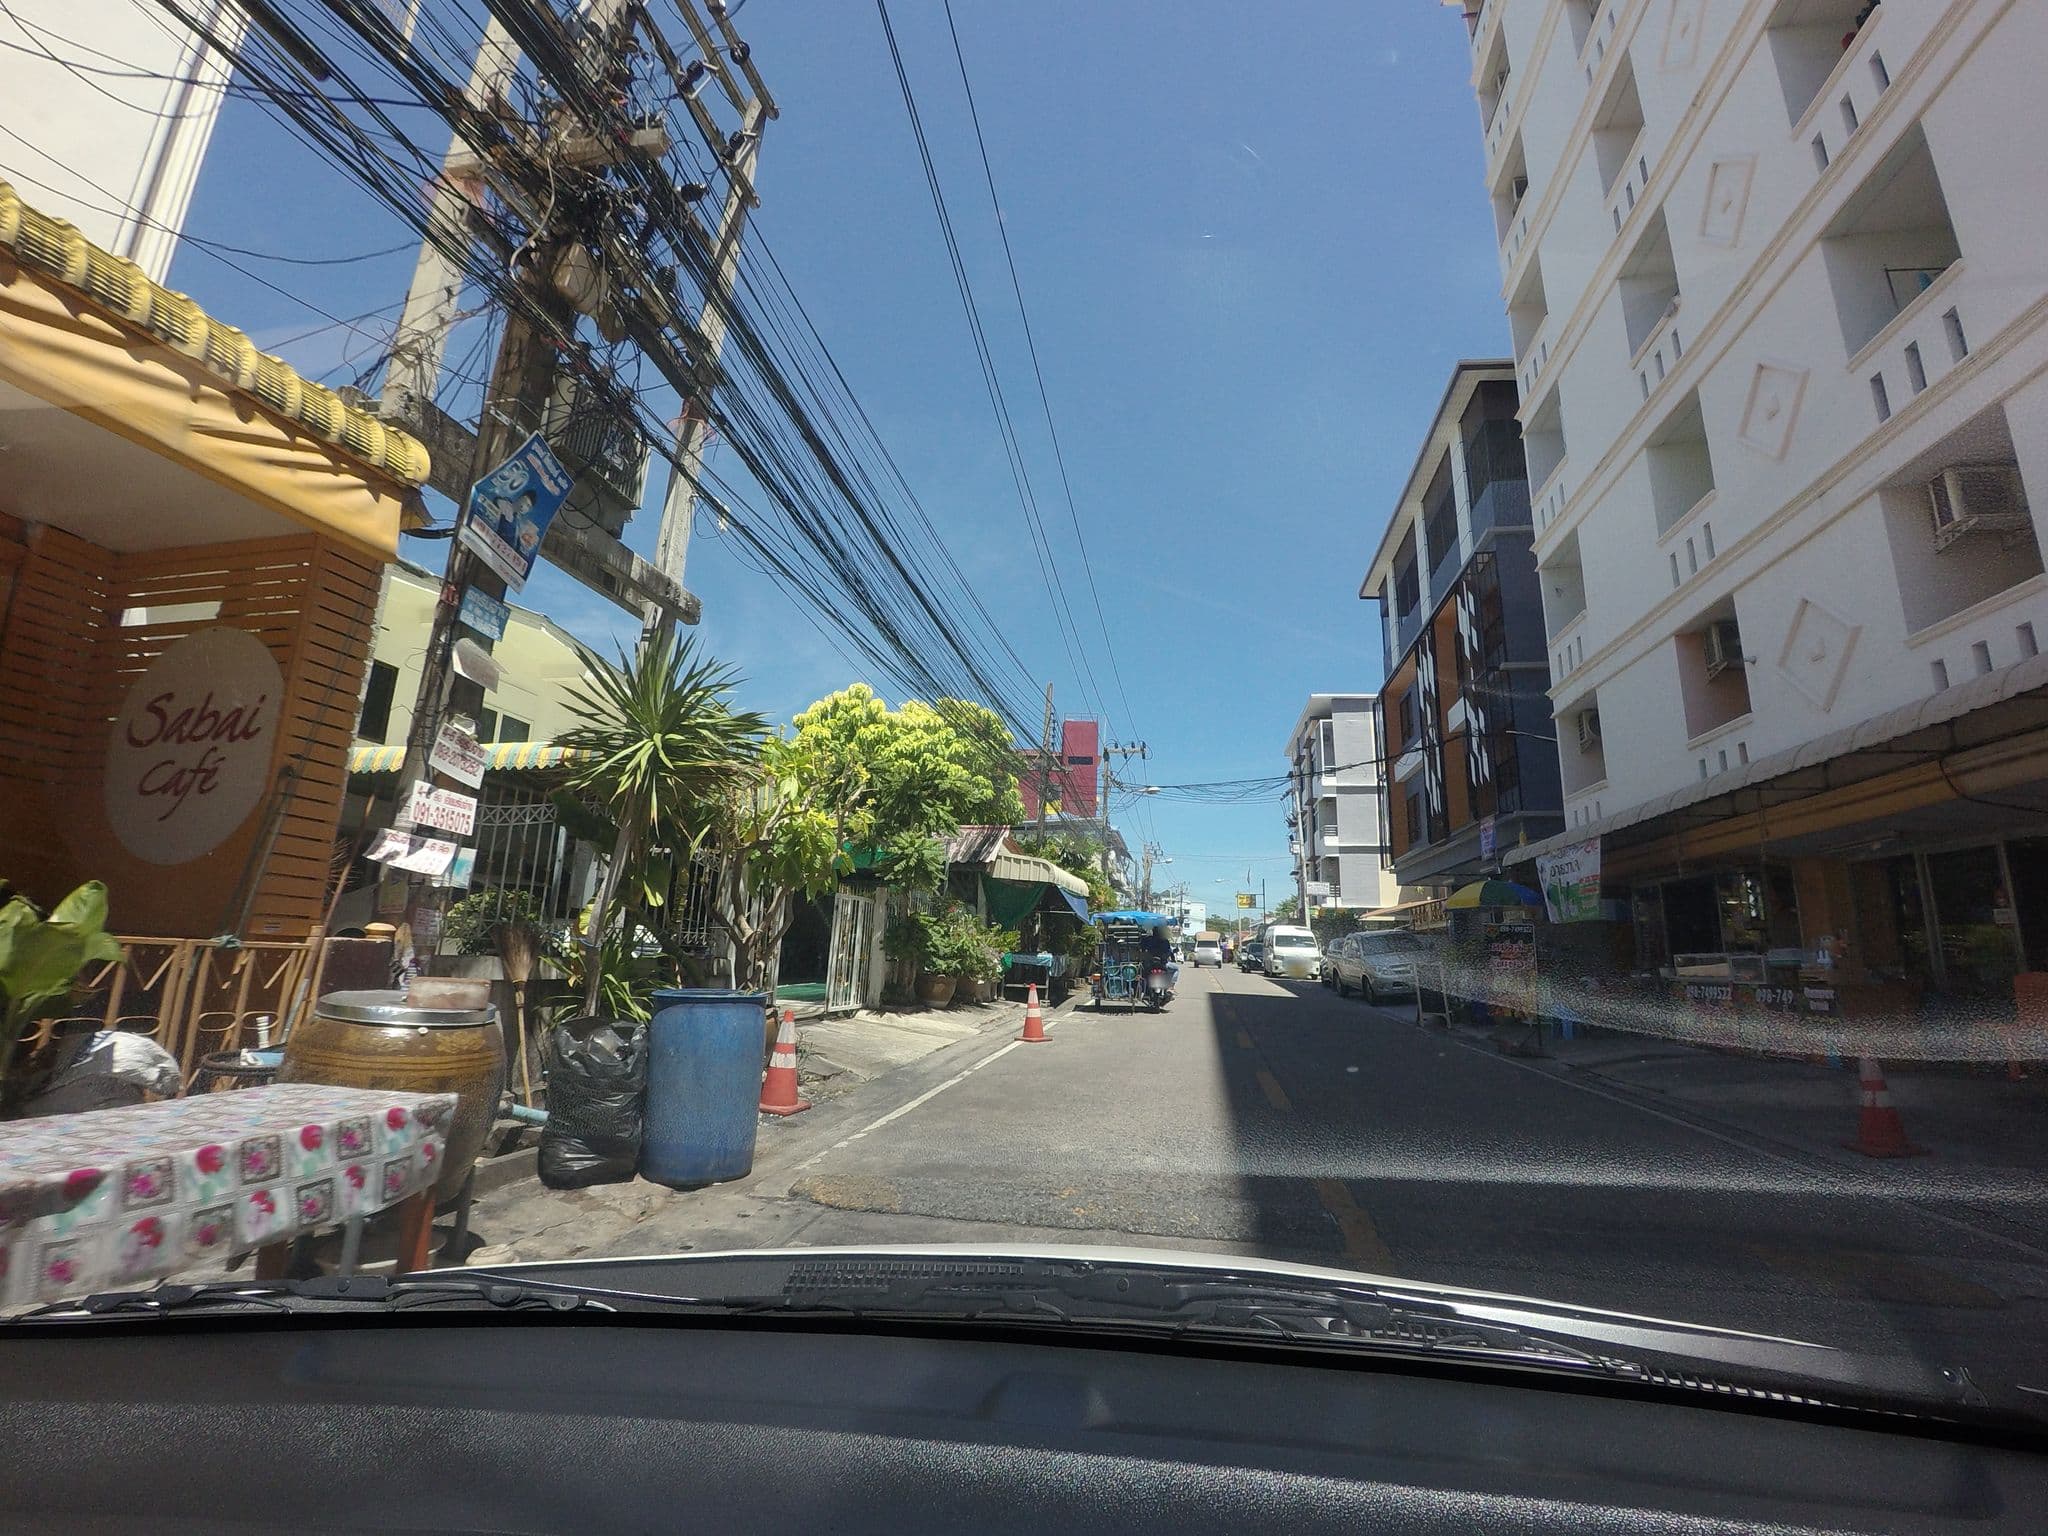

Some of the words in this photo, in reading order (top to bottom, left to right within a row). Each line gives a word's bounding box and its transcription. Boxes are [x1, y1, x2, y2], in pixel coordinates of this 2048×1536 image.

[127, 691, 266, 748] Sabai
[138, 746, 226, 821] Café
[413, 800, 471, 833] 091-3515075
